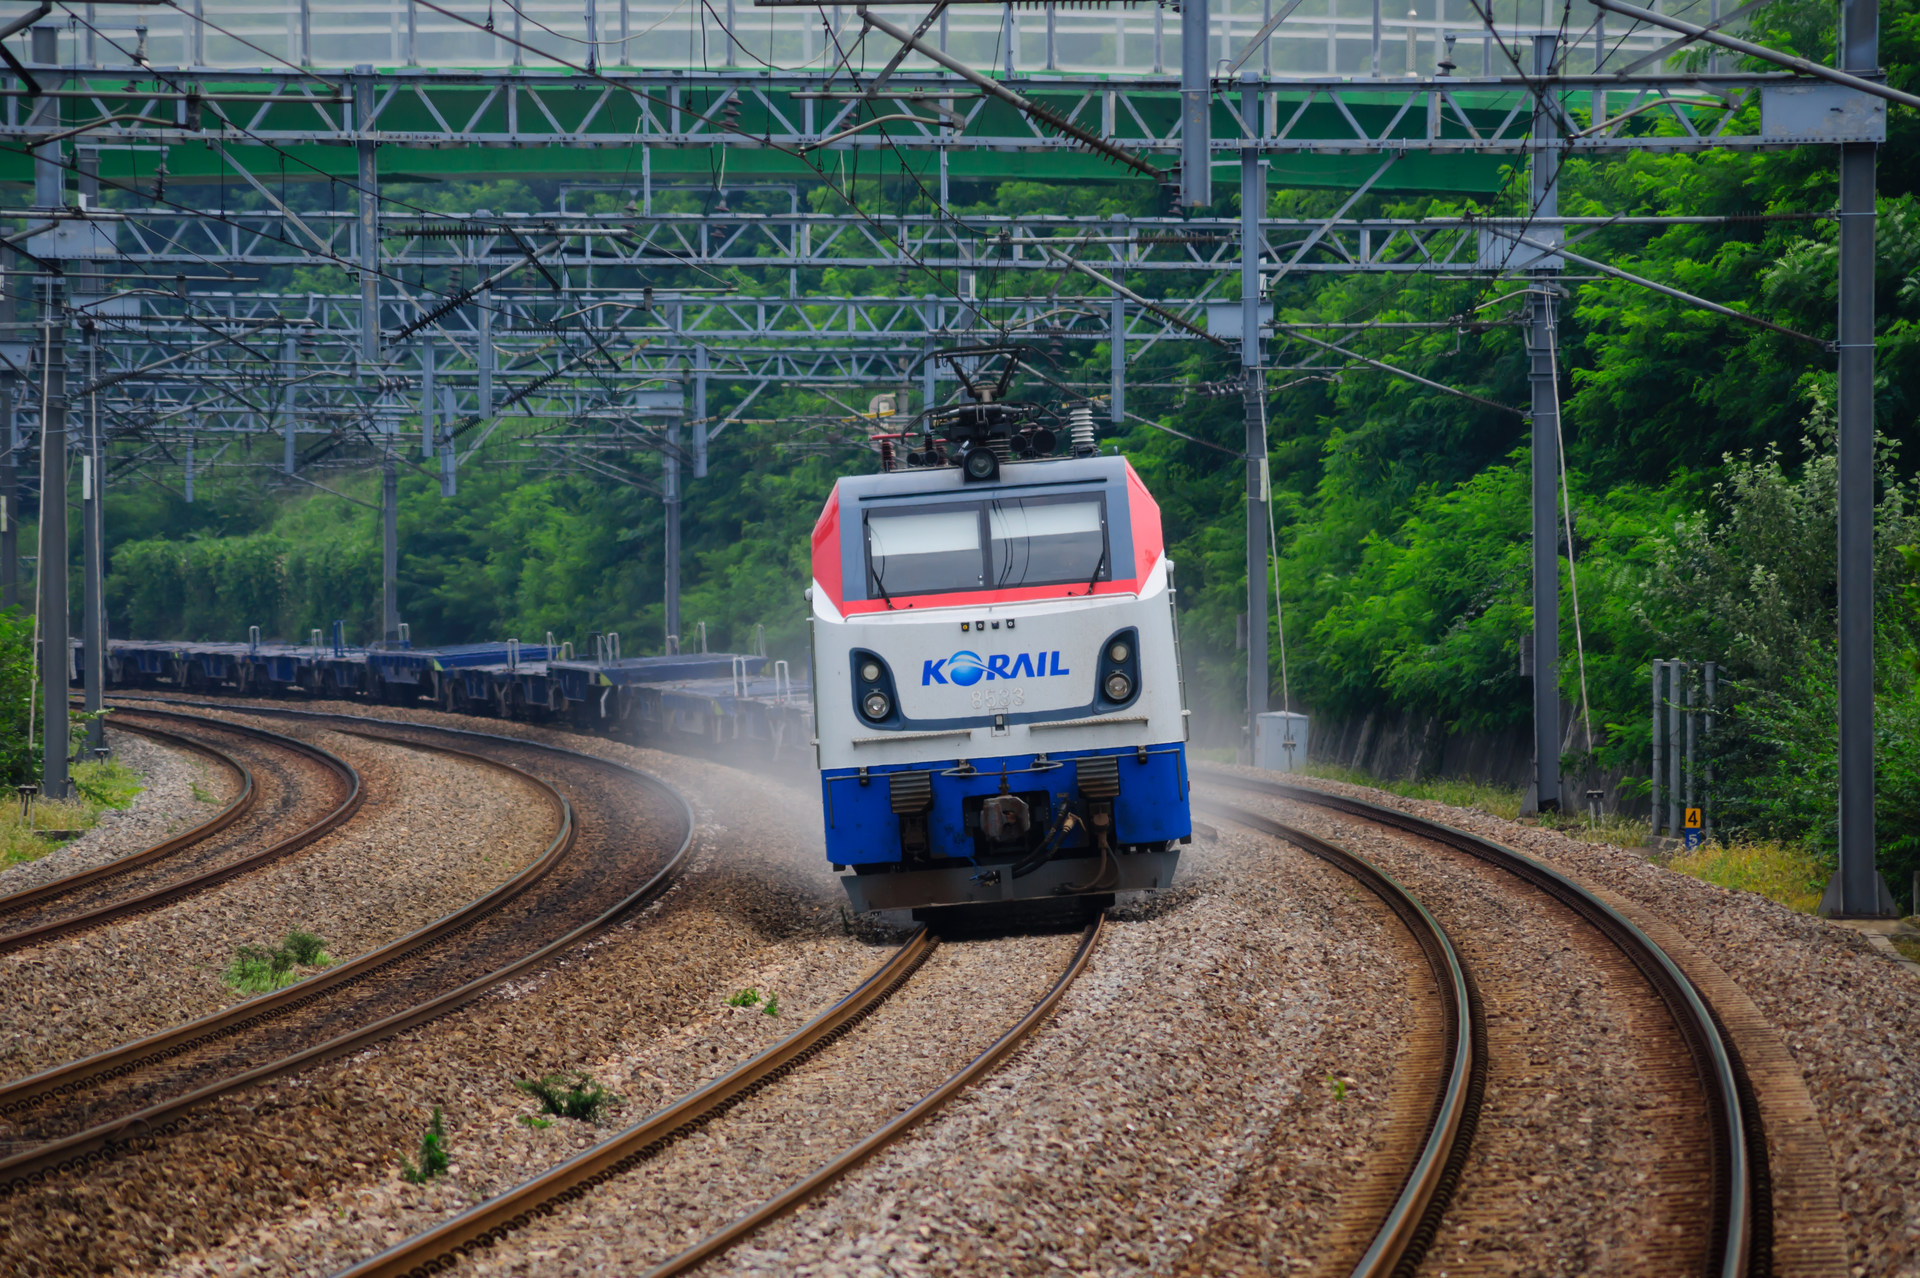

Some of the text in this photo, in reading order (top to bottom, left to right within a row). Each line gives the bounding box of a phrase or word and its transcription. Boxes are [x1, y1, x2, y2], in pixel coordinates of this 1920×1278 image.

[922, 650, 1070, 687] KORAIL
[971, 687, 1025, 709] 8533
[1687, 810, 1699, 826] 4
[1688, 833, 1698, 847] 5
